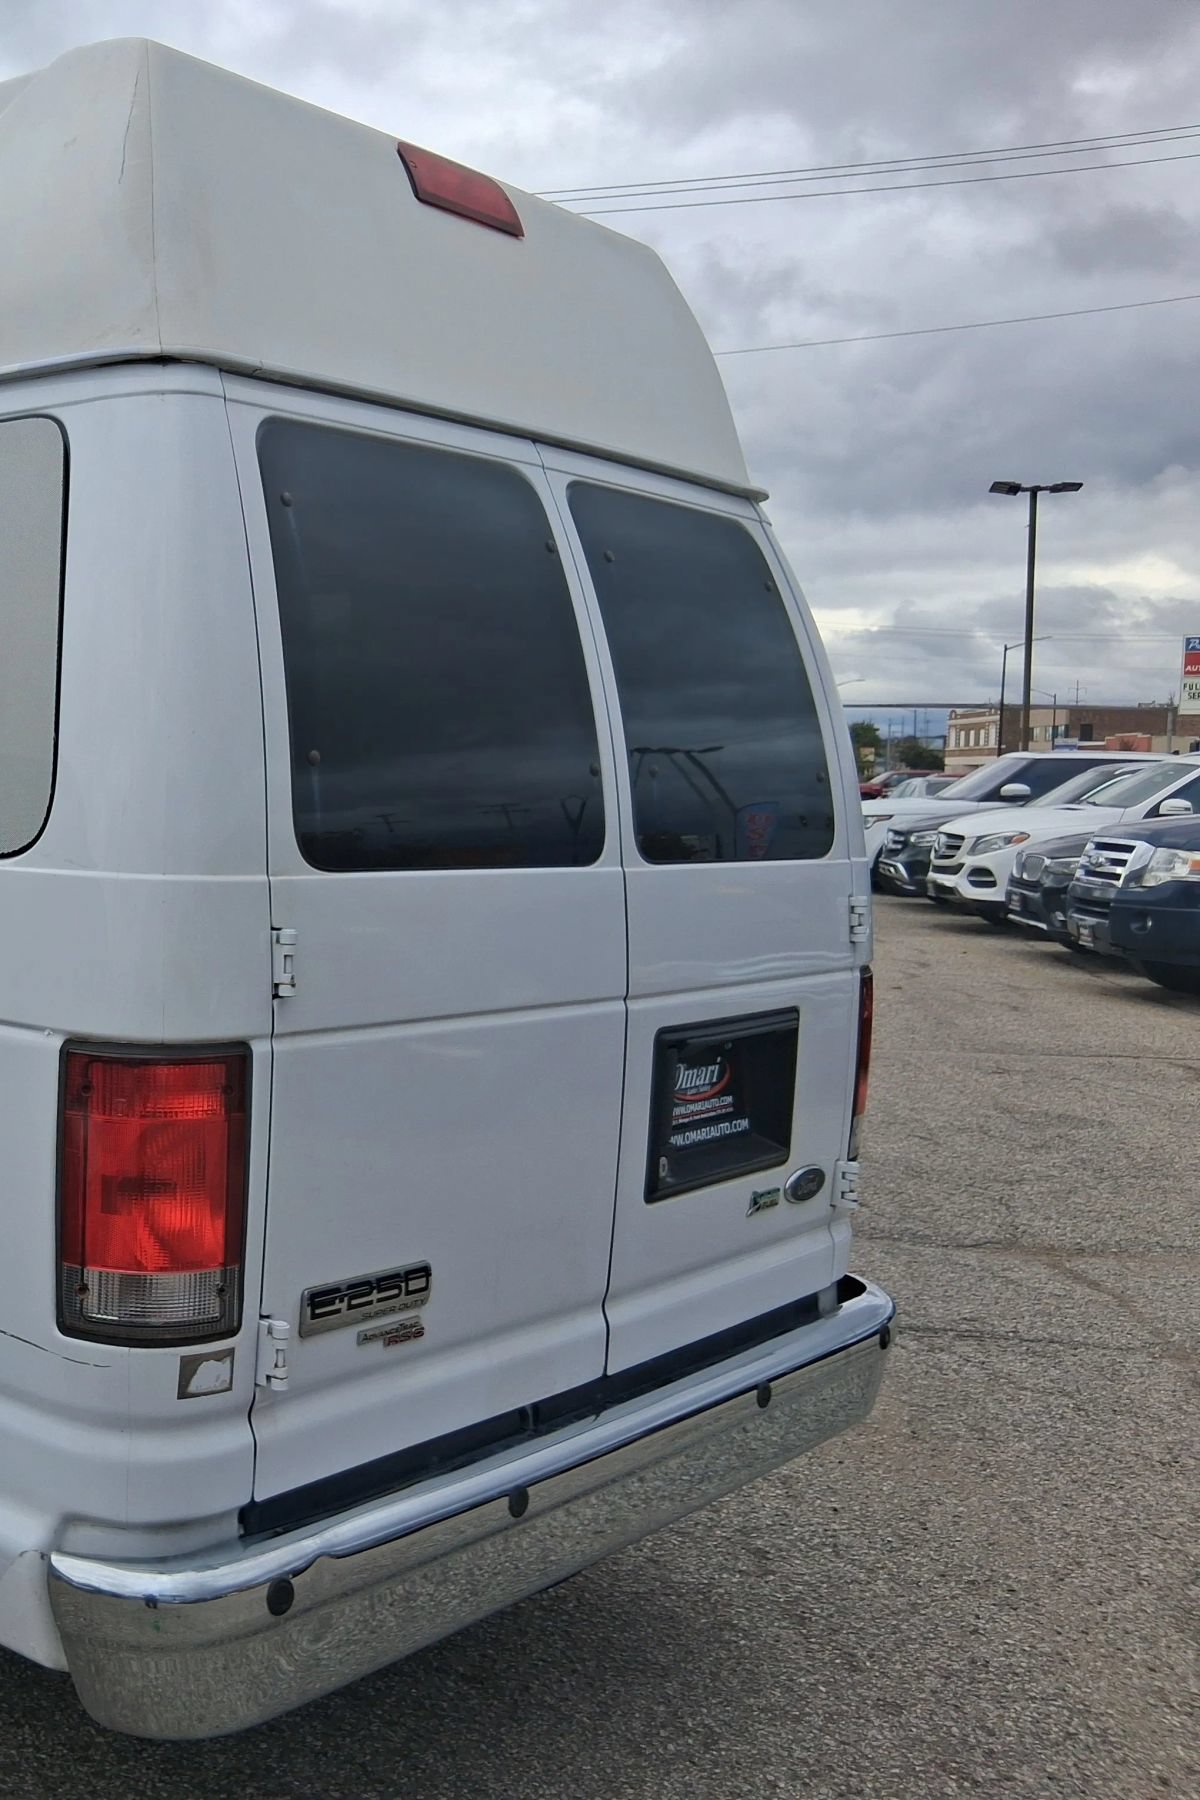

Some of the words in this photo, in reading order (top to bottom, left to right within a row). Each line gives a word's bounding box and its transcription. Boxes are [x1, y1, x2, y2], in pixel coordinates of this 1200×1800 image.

[1185, 664, 1200, 672] AU
[669, 1118, 749, 1147] WW.OMARIAUTO.COM
[308, 1265, 432, 1320] E-250
[361, 1305, 396, 1320] SUPER
[398, 1298, 426, 1311] DUTY
